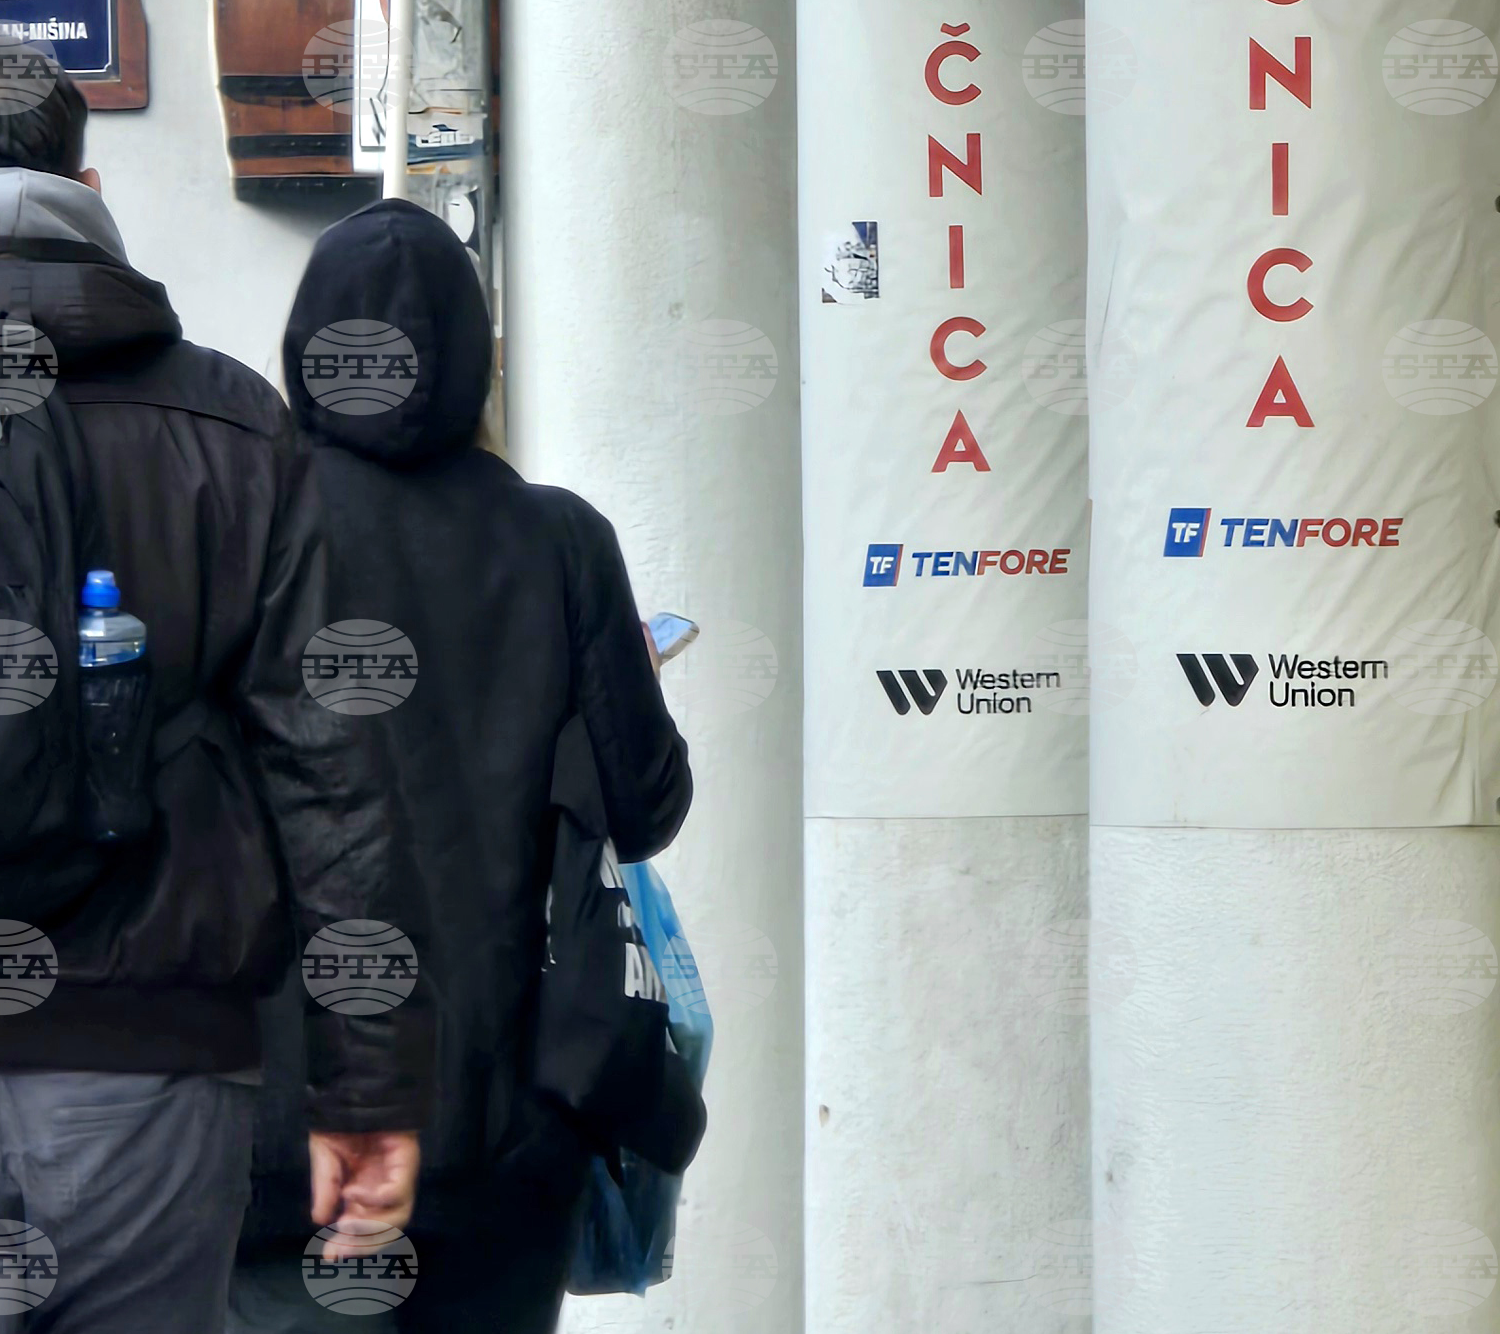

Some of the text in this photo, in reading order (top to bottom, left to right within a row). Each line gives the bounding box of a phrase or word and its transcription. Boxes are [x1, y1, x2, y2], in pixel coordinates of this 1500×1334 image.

[1172, 516, 1404, 549] TF TENFORE
[869, 547, 1071, 578] TF TENFORE
[955, 667, 1062, 691] Western
[1269, 652, 1389, 682] Western
[955, 690, 1033, 716] Union
[1268, 680, 1356, 709] Union
